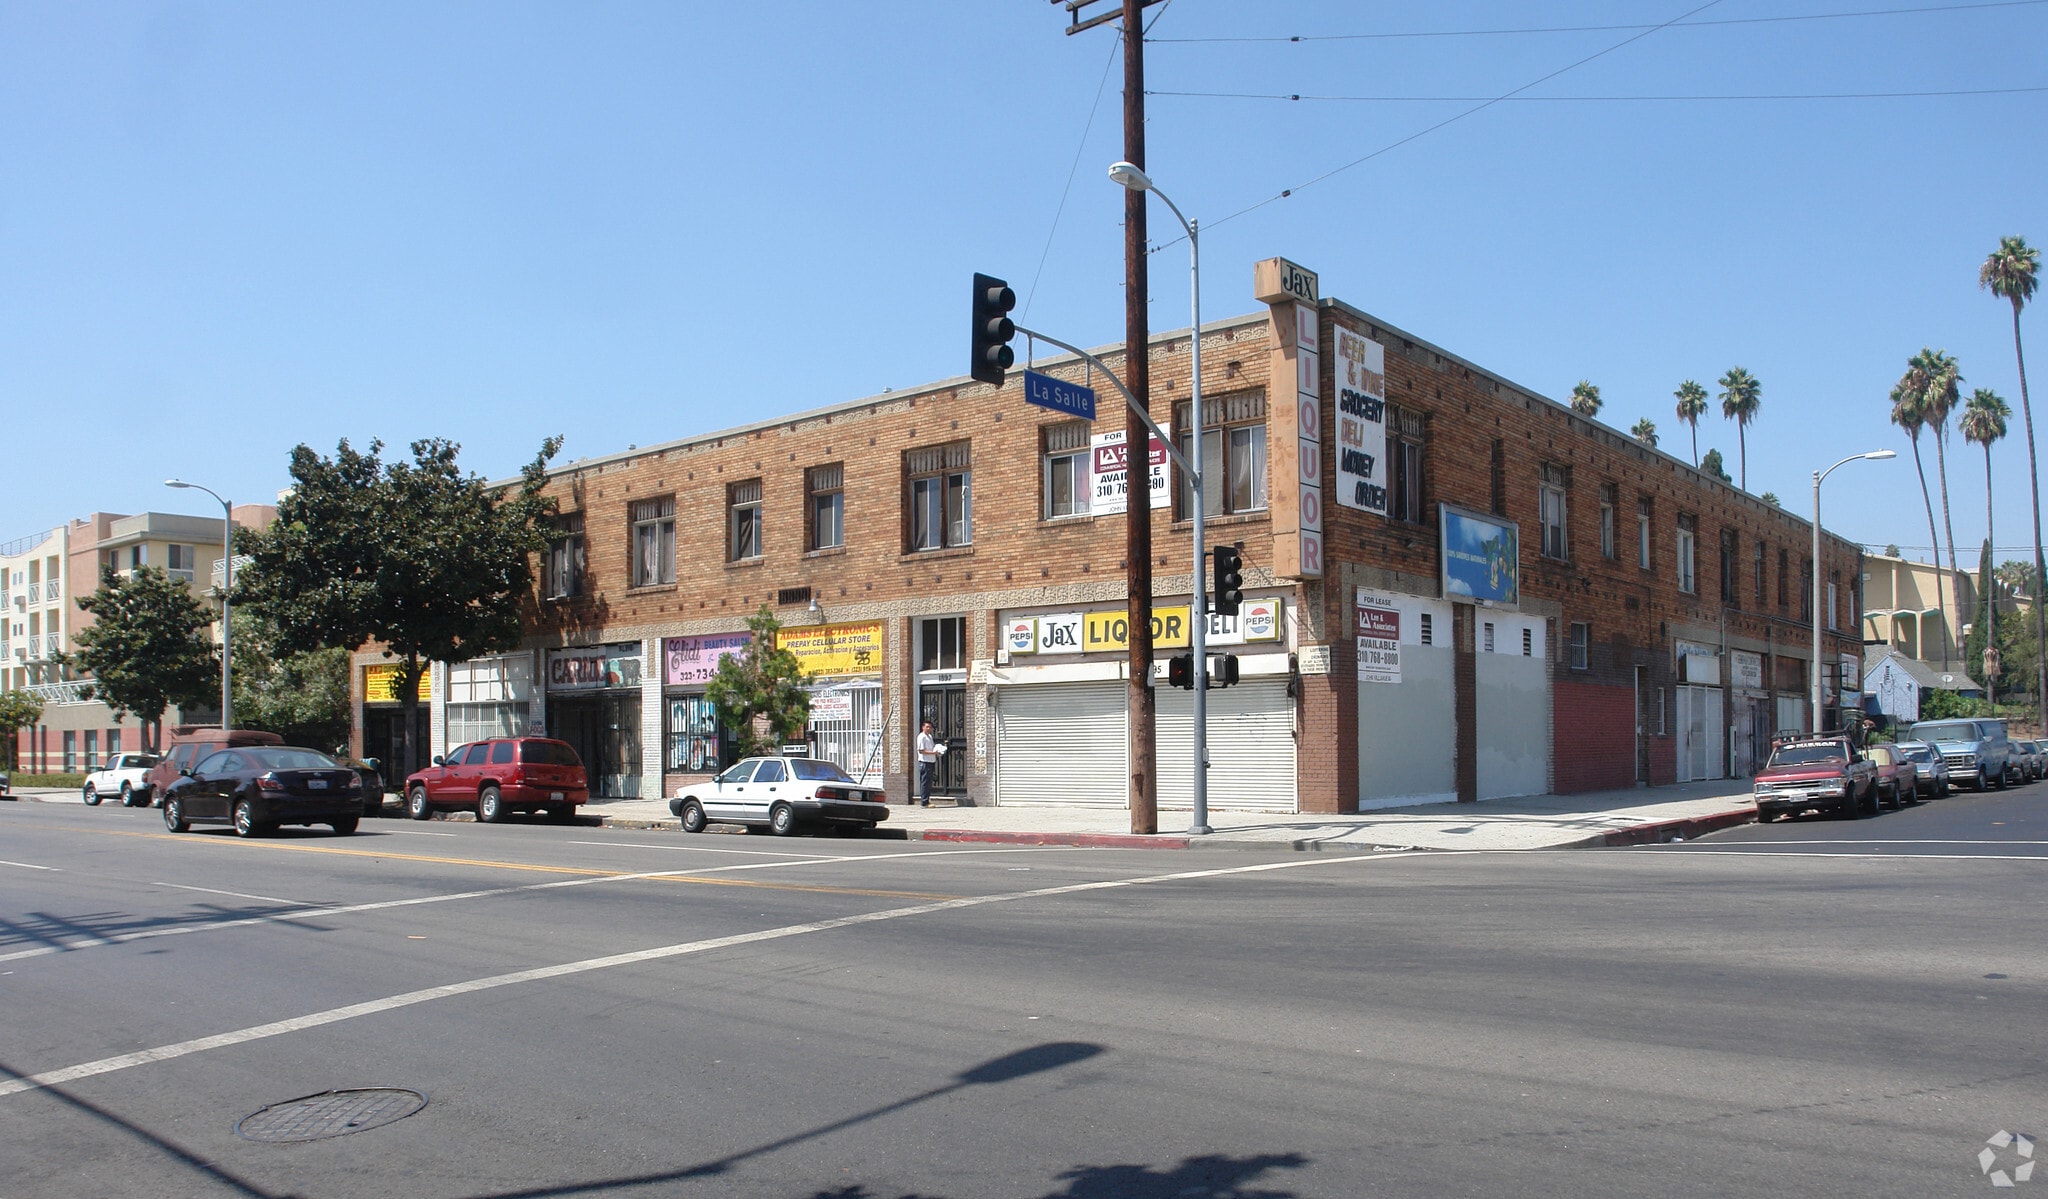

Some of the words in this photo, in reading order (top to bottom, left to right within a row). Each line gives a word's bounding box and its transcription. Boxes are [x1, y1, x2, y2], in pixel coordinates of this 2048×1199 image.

[1339, 332, 1367, 365] BEER
[1033, 380, 1049, 401] La
[1054, 386, 1088, 411] Salle
[1340, 388, 1385, 424] GROCERY
[1104, 432, 1122, 441] FOR
[1300, 310, 1319, 570] LIQUOR
[1341, 417, 1364, 449] DELI
[1341, 447, 1375, 479] MONEY
[1355, 481, 1386, 511] ORDER
[1363, 596, 1375, 604] FOR
[1375, 598, 1392, 607] LEASE
[704, 640, 727, 649] BEAUTY
[729, 637, 750, 648] SALON
[780, 629, 811, 640] ADAMS
[787, 640, 810, 648] PREPAY
[812, 637, 847, 646] CELLULAR
[848, 635, 871, 644] STORE
[1010, 632, 1033, 641] PEPSI
[1089, 616, 1182, 644] LIQOR
[1246, 615, 1275, 626] PEPSI
[1360, 638, 1397, 651] AVAILABLE
